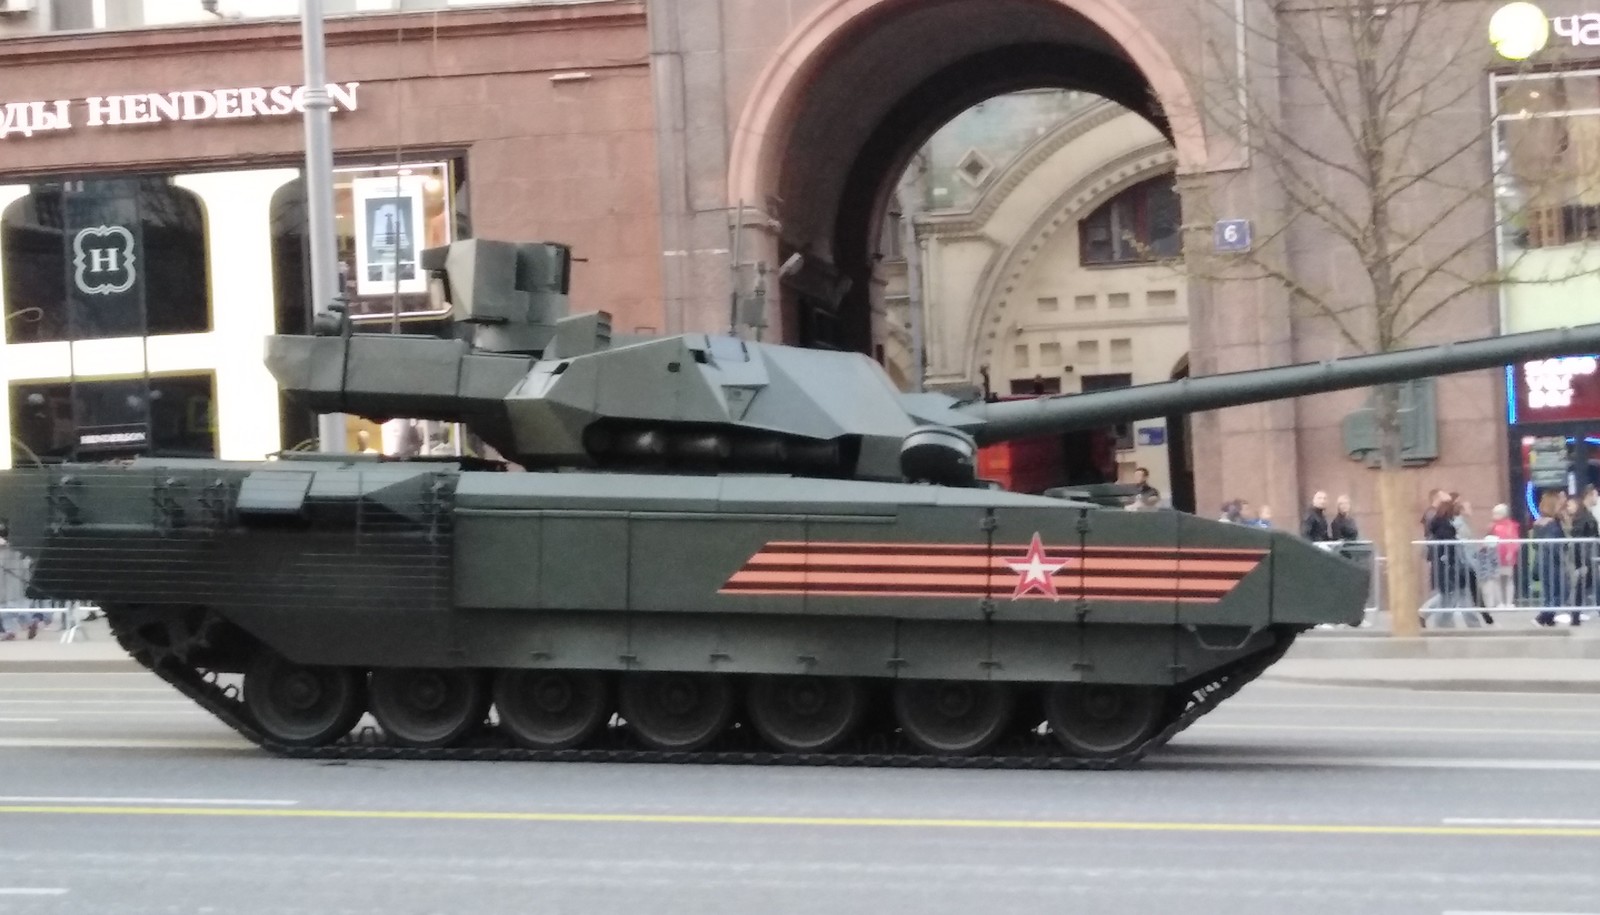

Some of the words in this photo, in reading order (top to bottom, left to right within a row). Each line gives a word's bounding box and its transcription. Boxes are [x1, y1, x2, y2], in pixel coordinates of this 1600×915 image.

[0, 100, 72, 138] ДЫ
[1224, 224, 1238, 242] 6
[90, 248, 120, 272] H
